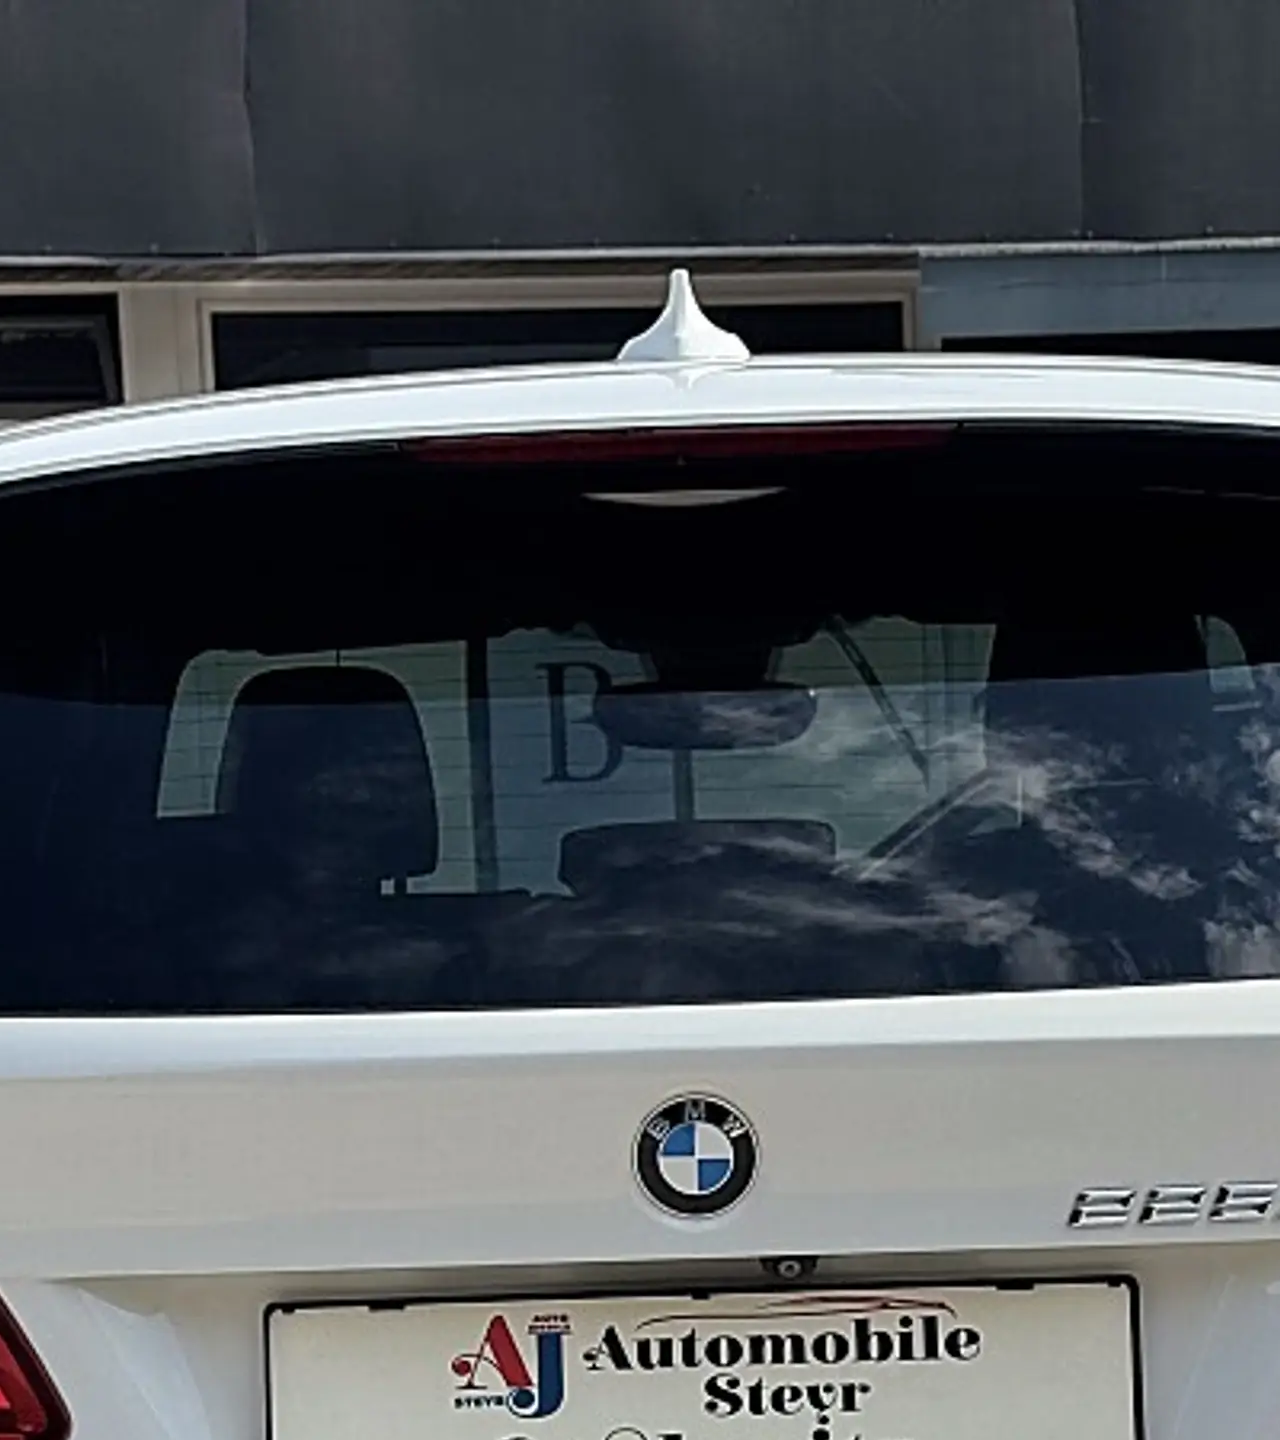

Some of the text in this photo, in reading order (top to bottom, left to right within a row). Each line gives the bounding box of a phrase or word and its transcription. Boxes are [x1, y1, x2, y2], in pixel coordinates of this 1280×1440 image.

[534, 661, 623, 784] B
[646, 1098, 749, 1141] BMW
[451, 1314, 565, 1418] AJ
[582, 1315, 981, 1371] Automobile
[704, 1373, 872, 1425] Steyr
